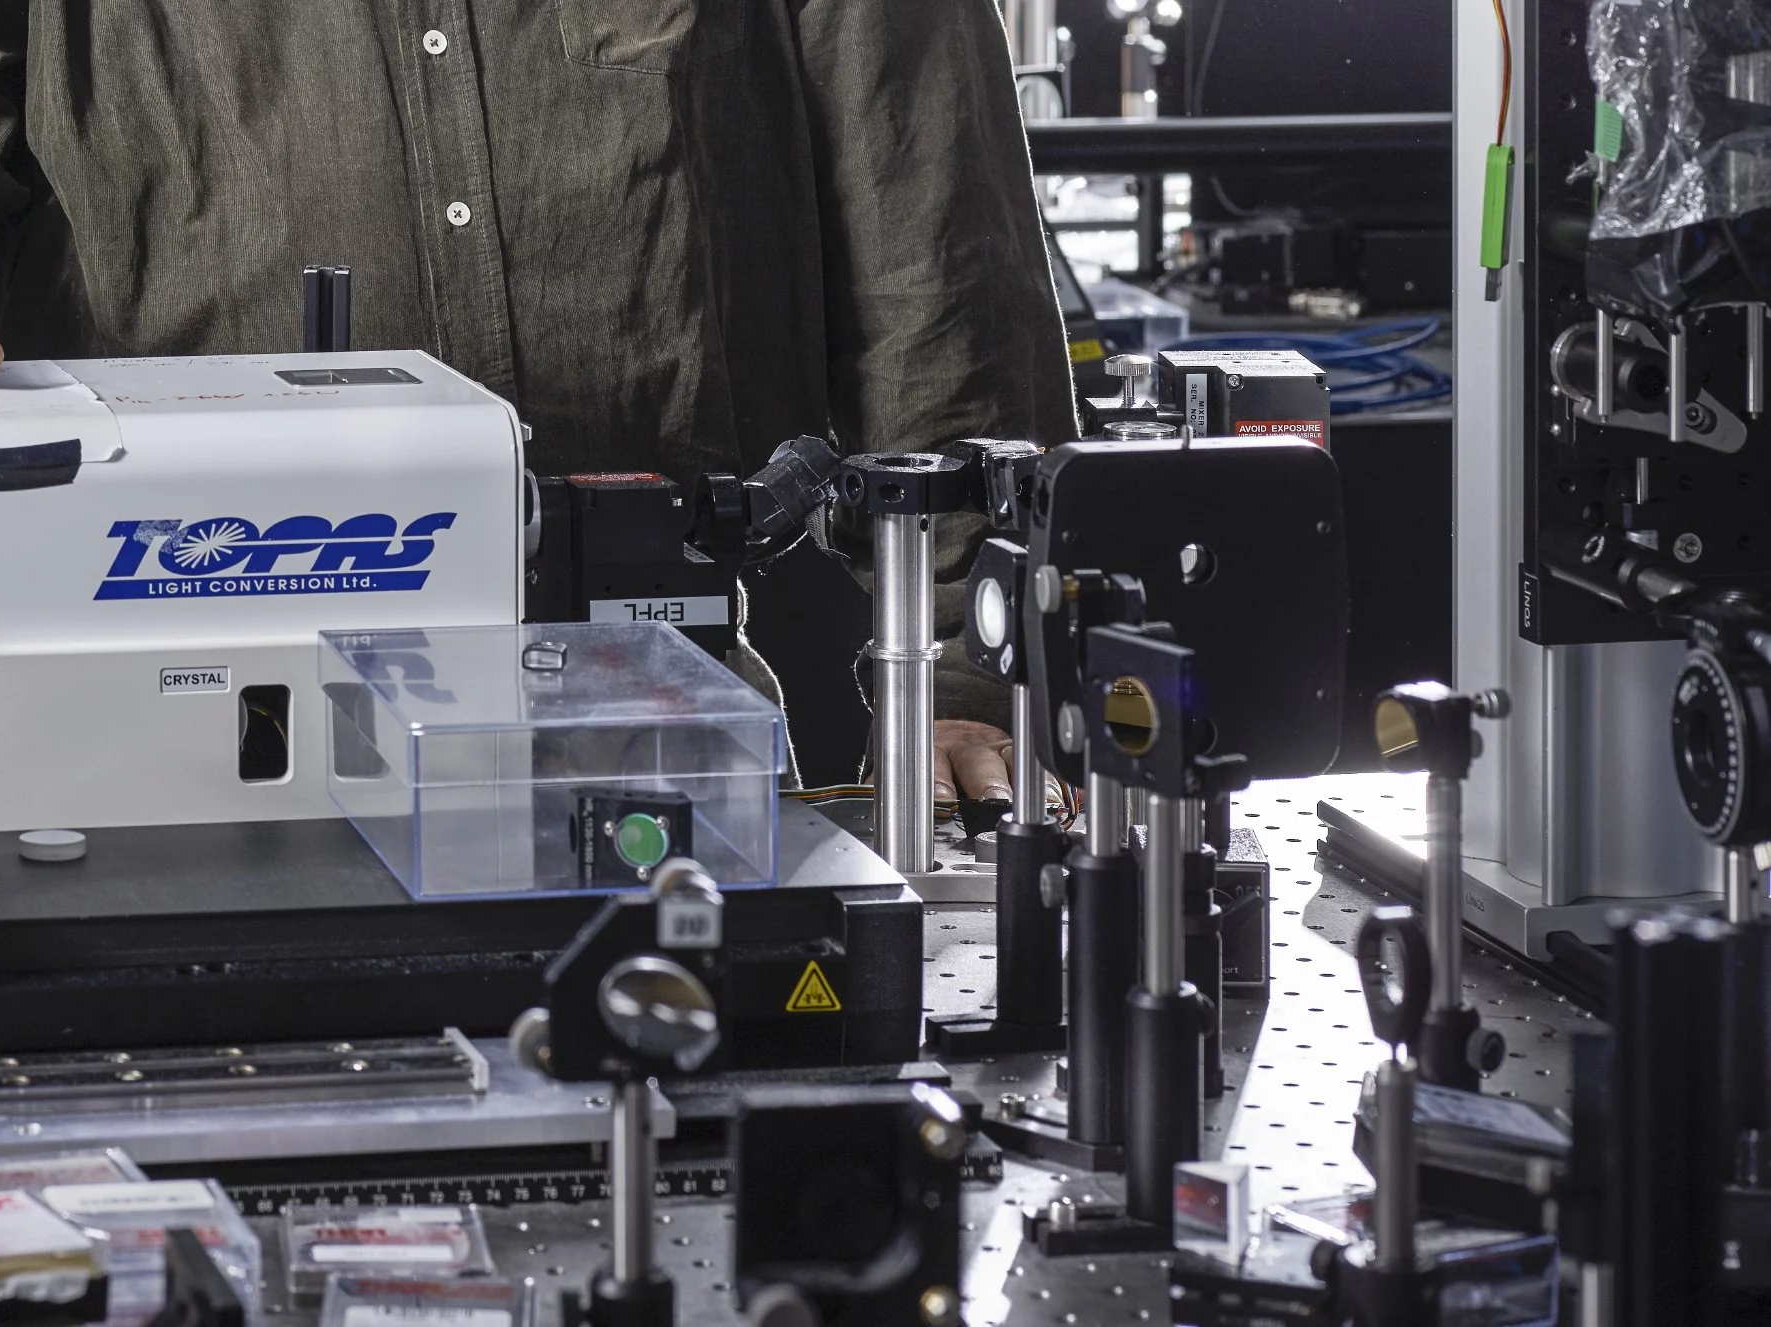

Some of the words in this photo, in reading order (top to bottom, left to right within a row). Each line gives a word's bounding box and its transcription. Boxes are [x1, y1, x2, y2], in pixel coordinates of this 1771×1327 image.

[1271, 424, 1321, 432] EXPOSURE
[105, 512, 458, 577] TOPAS
[148, 580, 203, 595] LIGHT
[209, 576, 336, 594] CONVERSION
[342, 575, 378, 589] Ltd.
[623, 601, 685, 622] EPFL
[1524, 580, 1532, 628] LINOS
[163, 672, 226, 686] CRYSTAL
[1465, 890, 1485, 912] LINOS
[429, 1190, 445, 1204] 72
[457, 1189, 473, 1203] 73
[485, 1188, 501, 1202] 74
[514, 1187, 530, 1201] 75
[542, 1185, 559, 1200] 76
[570, 1184, 586, 1198] 77
